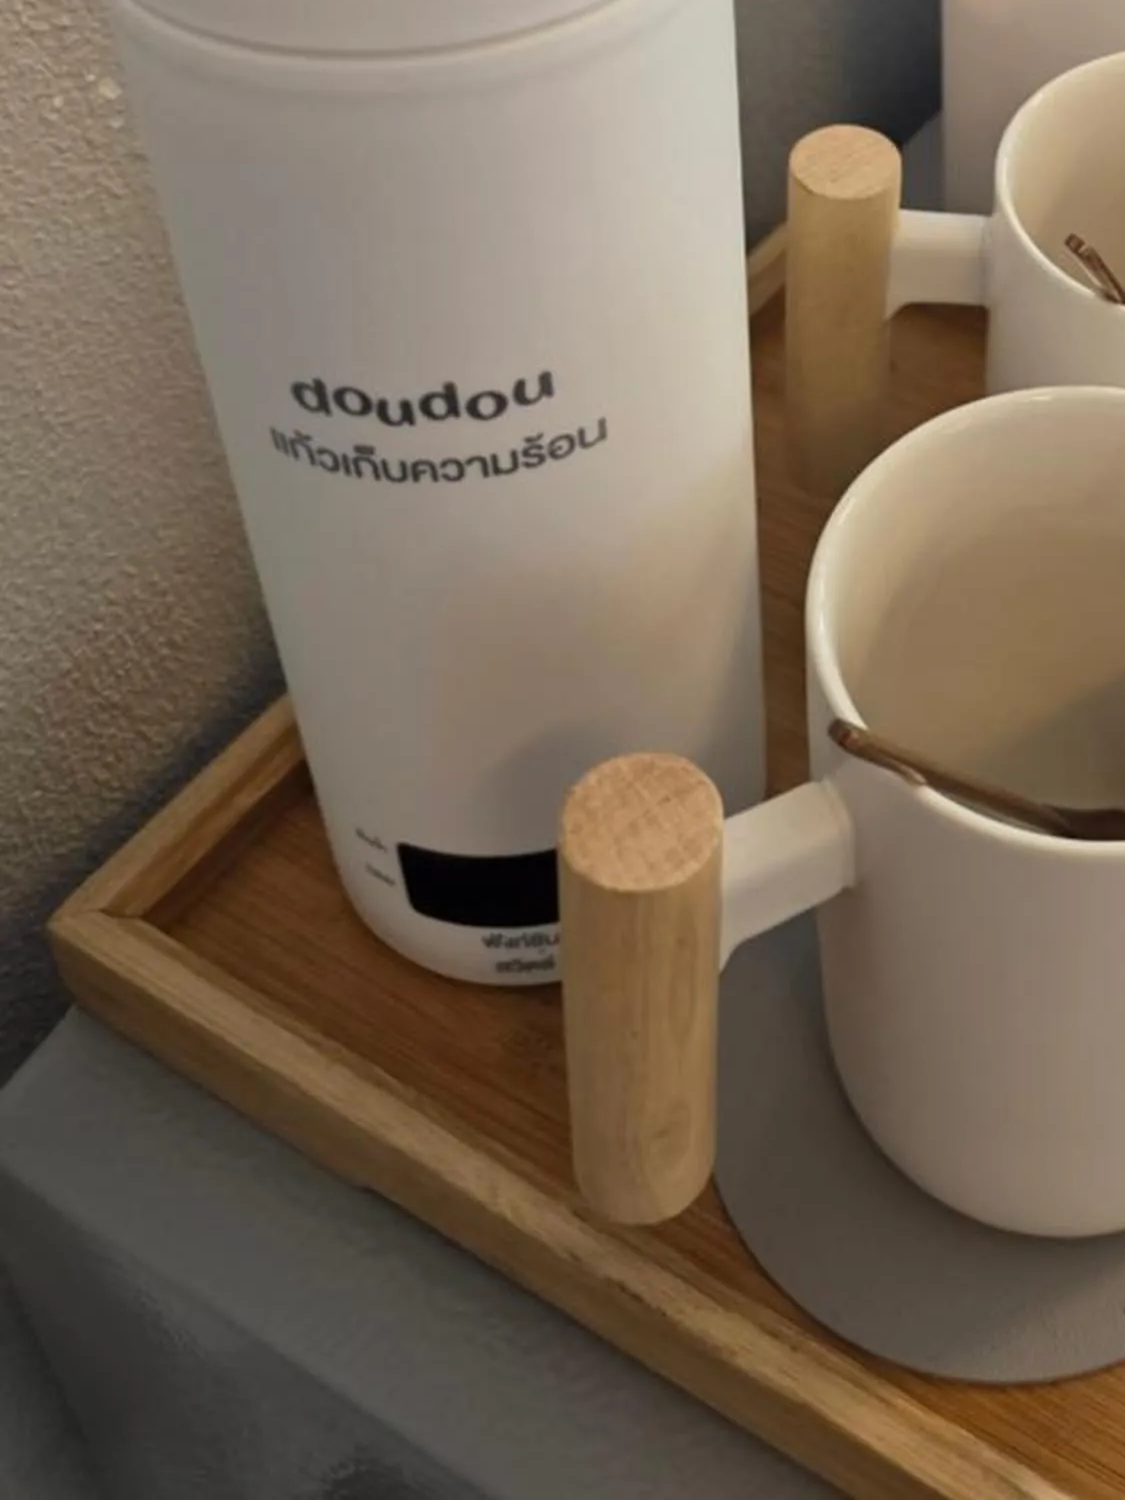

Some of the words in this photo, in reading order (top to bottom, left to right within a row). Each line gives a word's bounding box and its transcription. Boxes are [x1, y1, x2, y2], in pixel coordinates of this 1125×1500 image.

[291, 370, 556, 426] doudou
[268, 417, 608, 484] แก้วเก็บความร้อน
